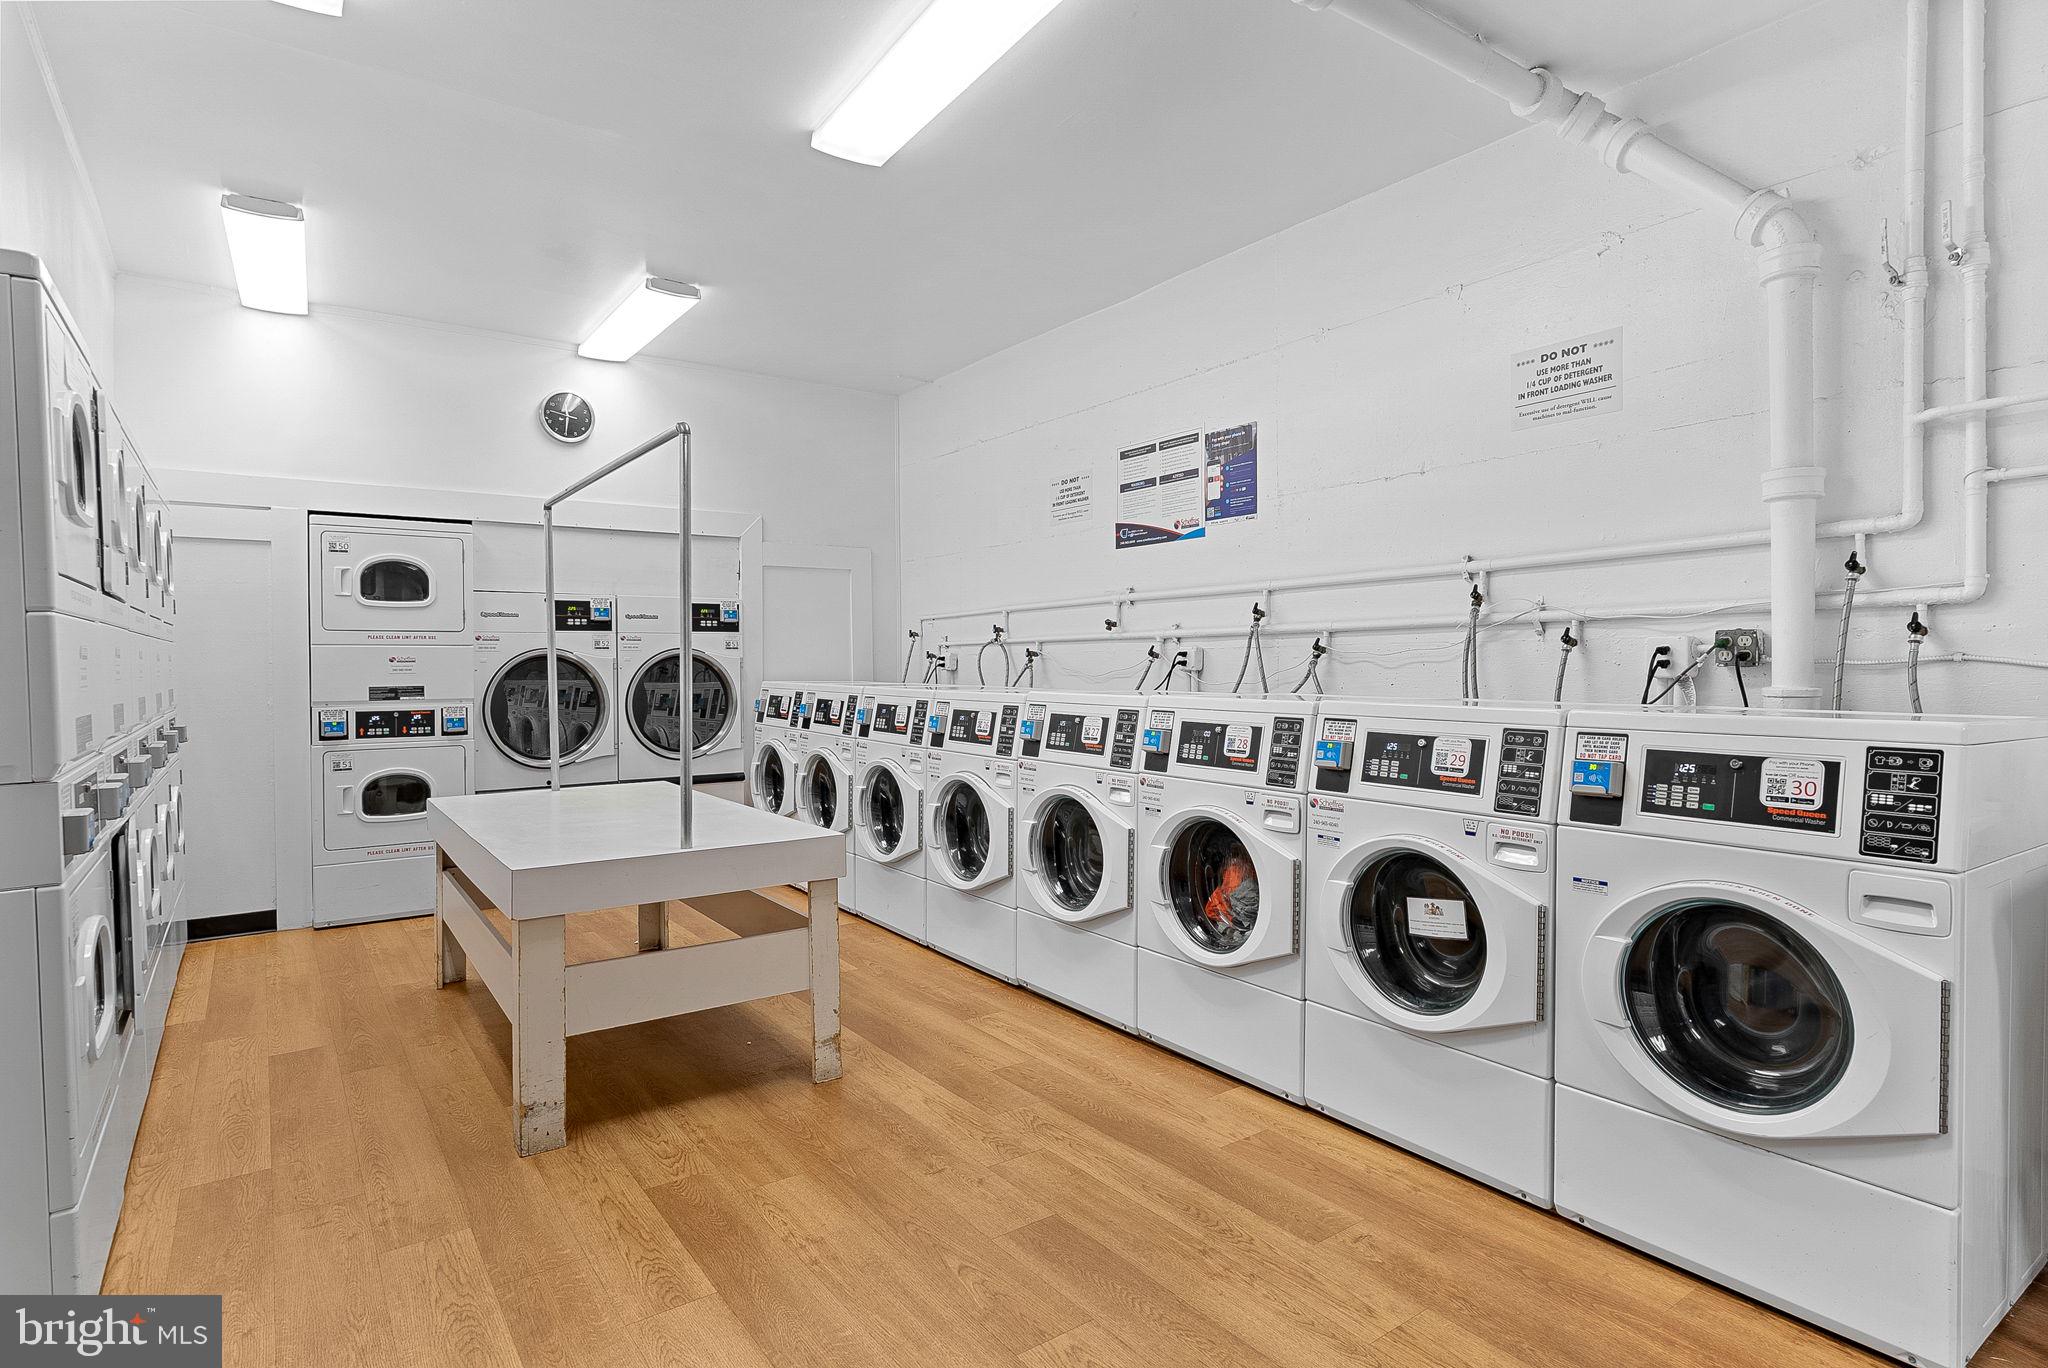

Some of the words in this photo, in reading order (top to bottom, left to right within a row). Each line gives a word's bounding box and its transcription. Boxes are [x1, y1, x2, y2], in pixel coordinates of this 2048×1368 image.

[1540, 351, 1557, 363] DO
[1561, 343, 1588, 358] NOT
[1536, 368, 1549, 377] USE
[1550, 363, 1570, 375] MORE
[1571, 357, 1592, 369] THAN
[1526, 379, 1536, 389] 1/4
[1538, 376, 1551, 387] CUP
[1553, 373, 1563, 384] OF
[1564, 365, 1604, 380] DETERGENT
[1517, 392, 1525, 401] IN
[1526, 387, 1549, 399] FRONT
[1550, 380, 1582, 394] LOADING
[1583, 373, 1614, 388] WASHER
[338, 543, 349, 551] 50
[1090, 728, 1100, 737] 27
[1237, 738, 1248, 750] 28
[1450, 753, 1466, 767] 29
[1791, 780, 1817, 797] 30
[1767, 807, 1796, 816] Speed
[1797, 810, 1827, 819] Queen
[1772, 815, 1804, 823] Commercial
[1804, 817, 1826, 826] Washer
[1512, 830, 1534, 839] PODS!!
[1748, 888, 1781, 901] WHEN
[1784, 901, 1815, 917] DONE
